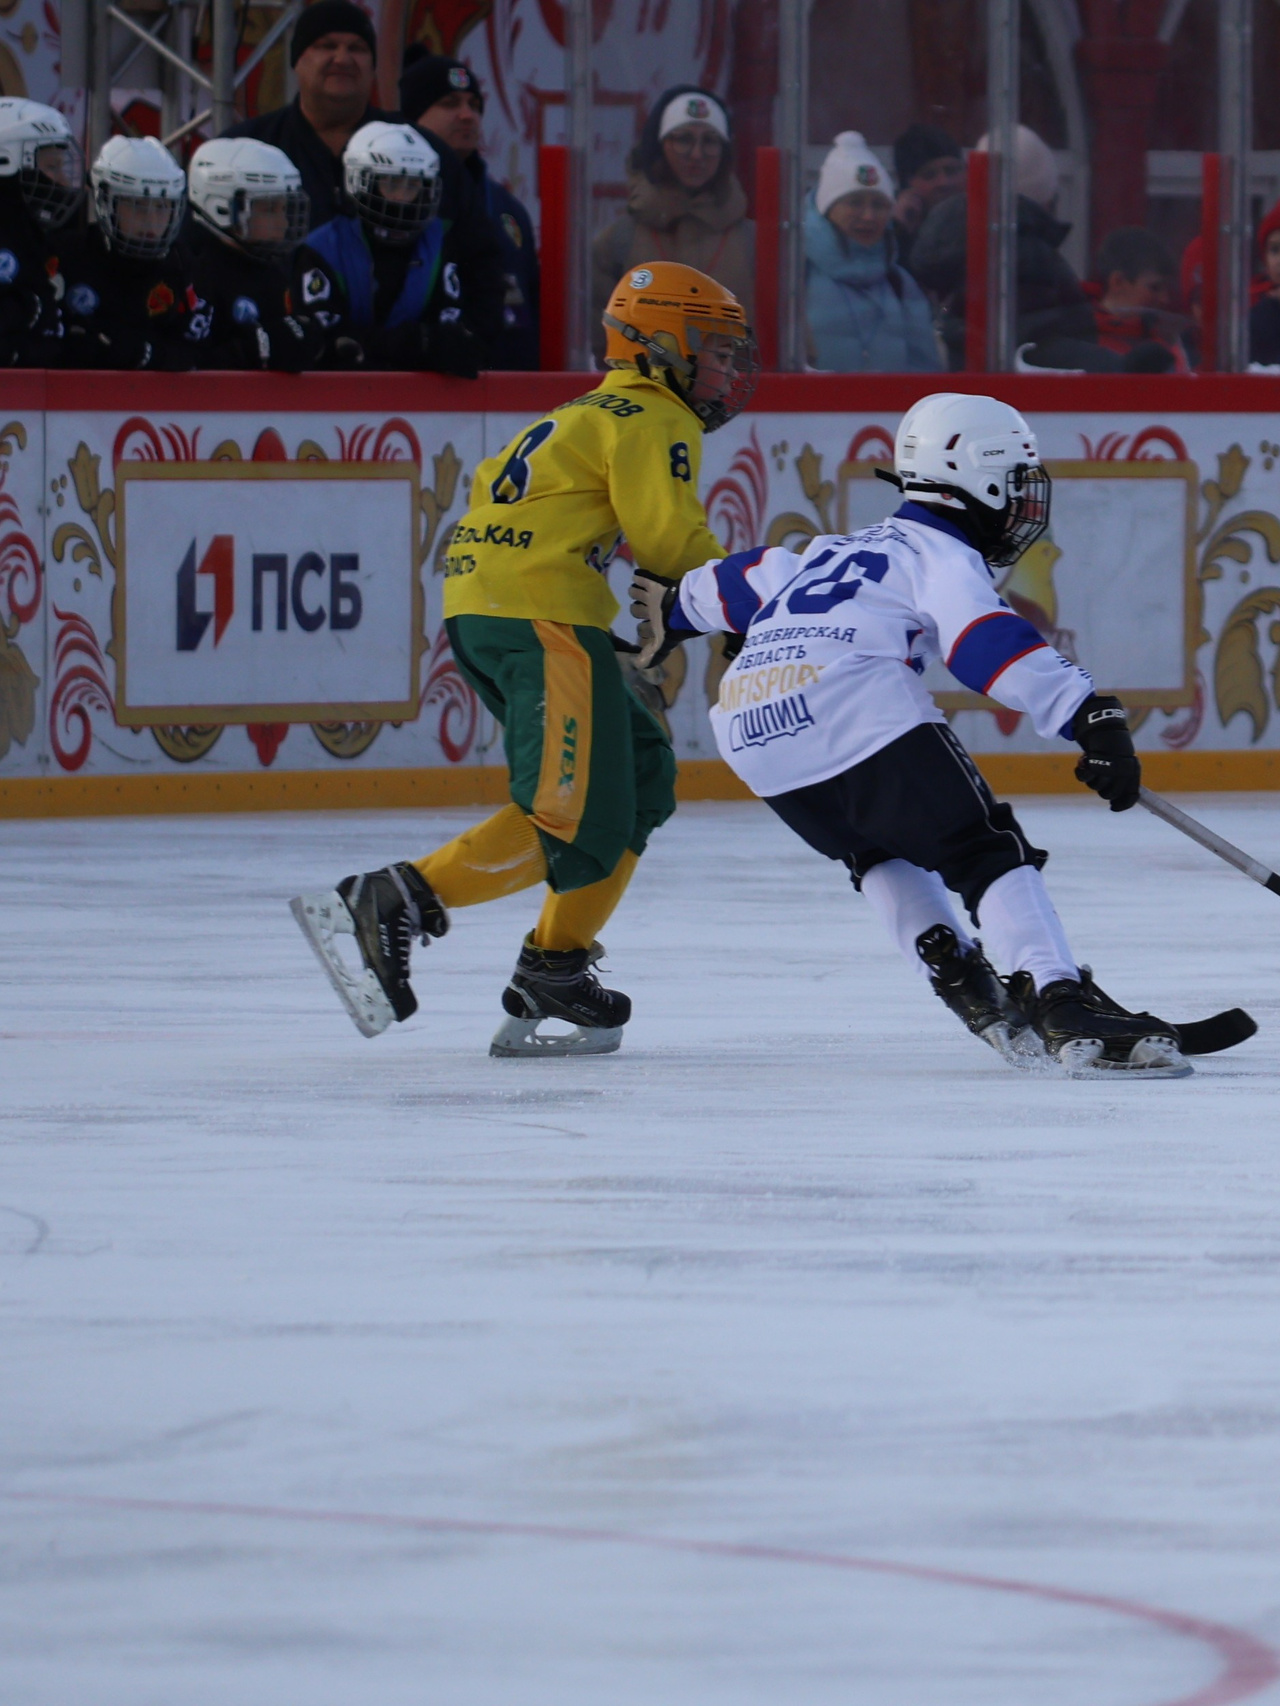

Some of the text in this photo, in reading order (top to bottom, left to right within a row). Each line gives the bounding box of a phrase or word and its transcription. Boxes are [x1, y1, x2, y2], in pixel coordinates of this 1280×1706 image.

[670, 442, 692, 482] 8
[983, 449, 1005, 457] CCM
[251, 551, 363, 632] ПСБ
[1088, 758, 1112, 766] STEX
